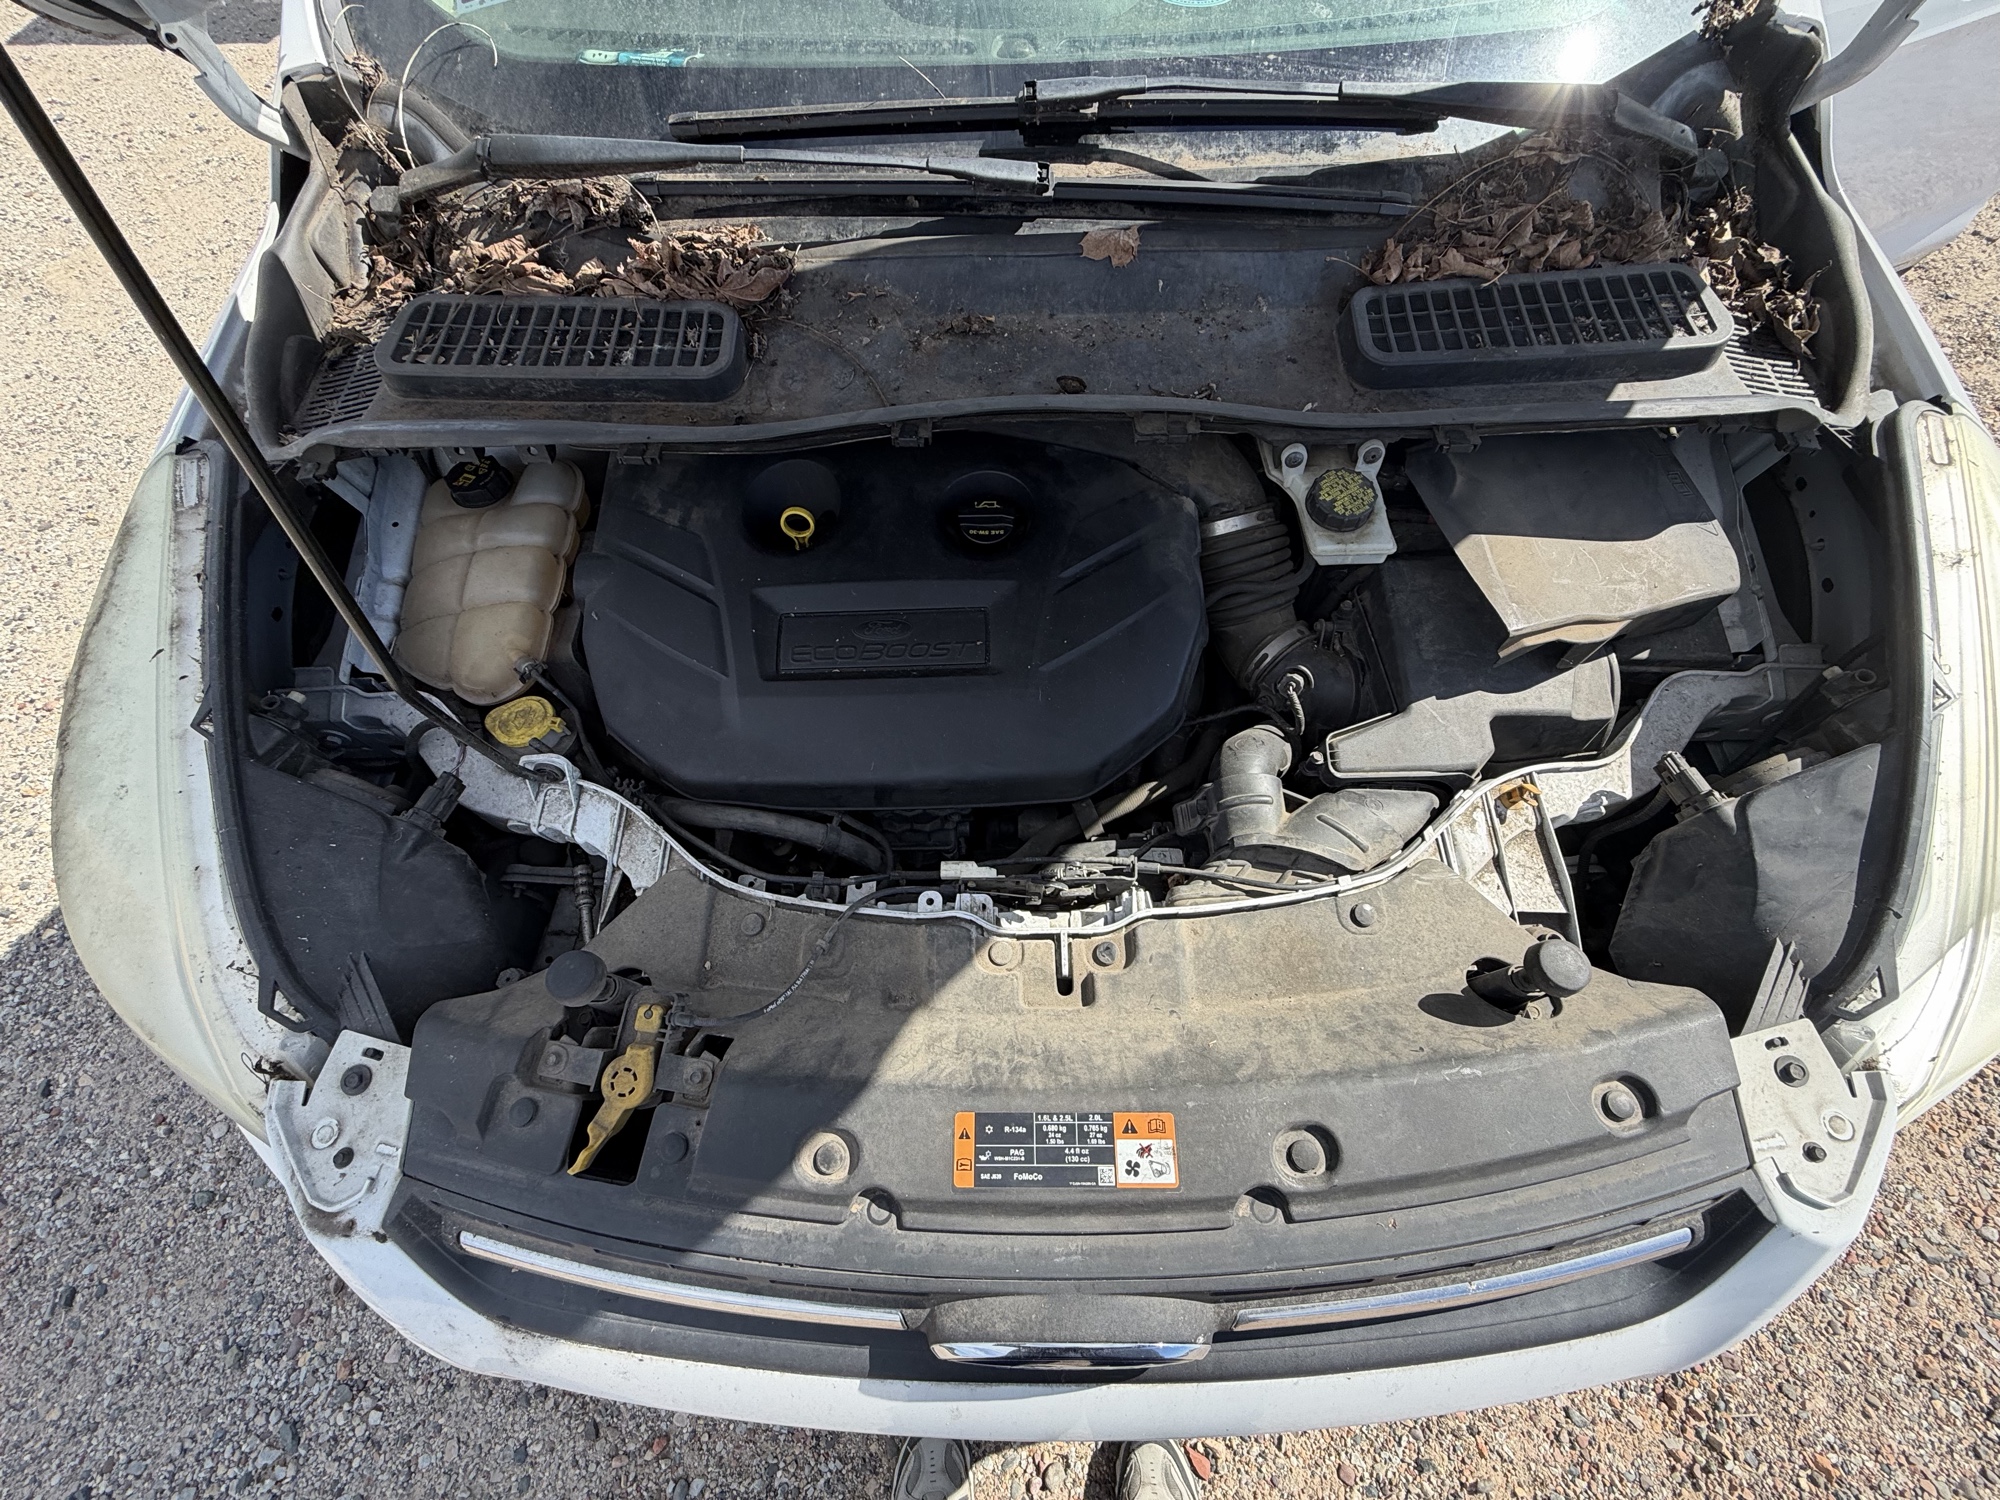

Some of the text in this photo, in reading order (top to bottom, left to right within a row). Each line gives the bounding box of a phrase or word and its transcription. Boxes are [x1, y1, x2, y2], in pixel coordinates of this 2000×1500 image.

[864, 621, 902, 635] Ford
[790, 641, 976, 663] ECOBOOST
[1059, 1125, 1067, 1133] kg
[1084, 1124, 1108, 1133] 0.765 kg
[1009, 1148, 1025, 1156] PAG
[1013, 1172, 1043, 1180] FoMoCo
